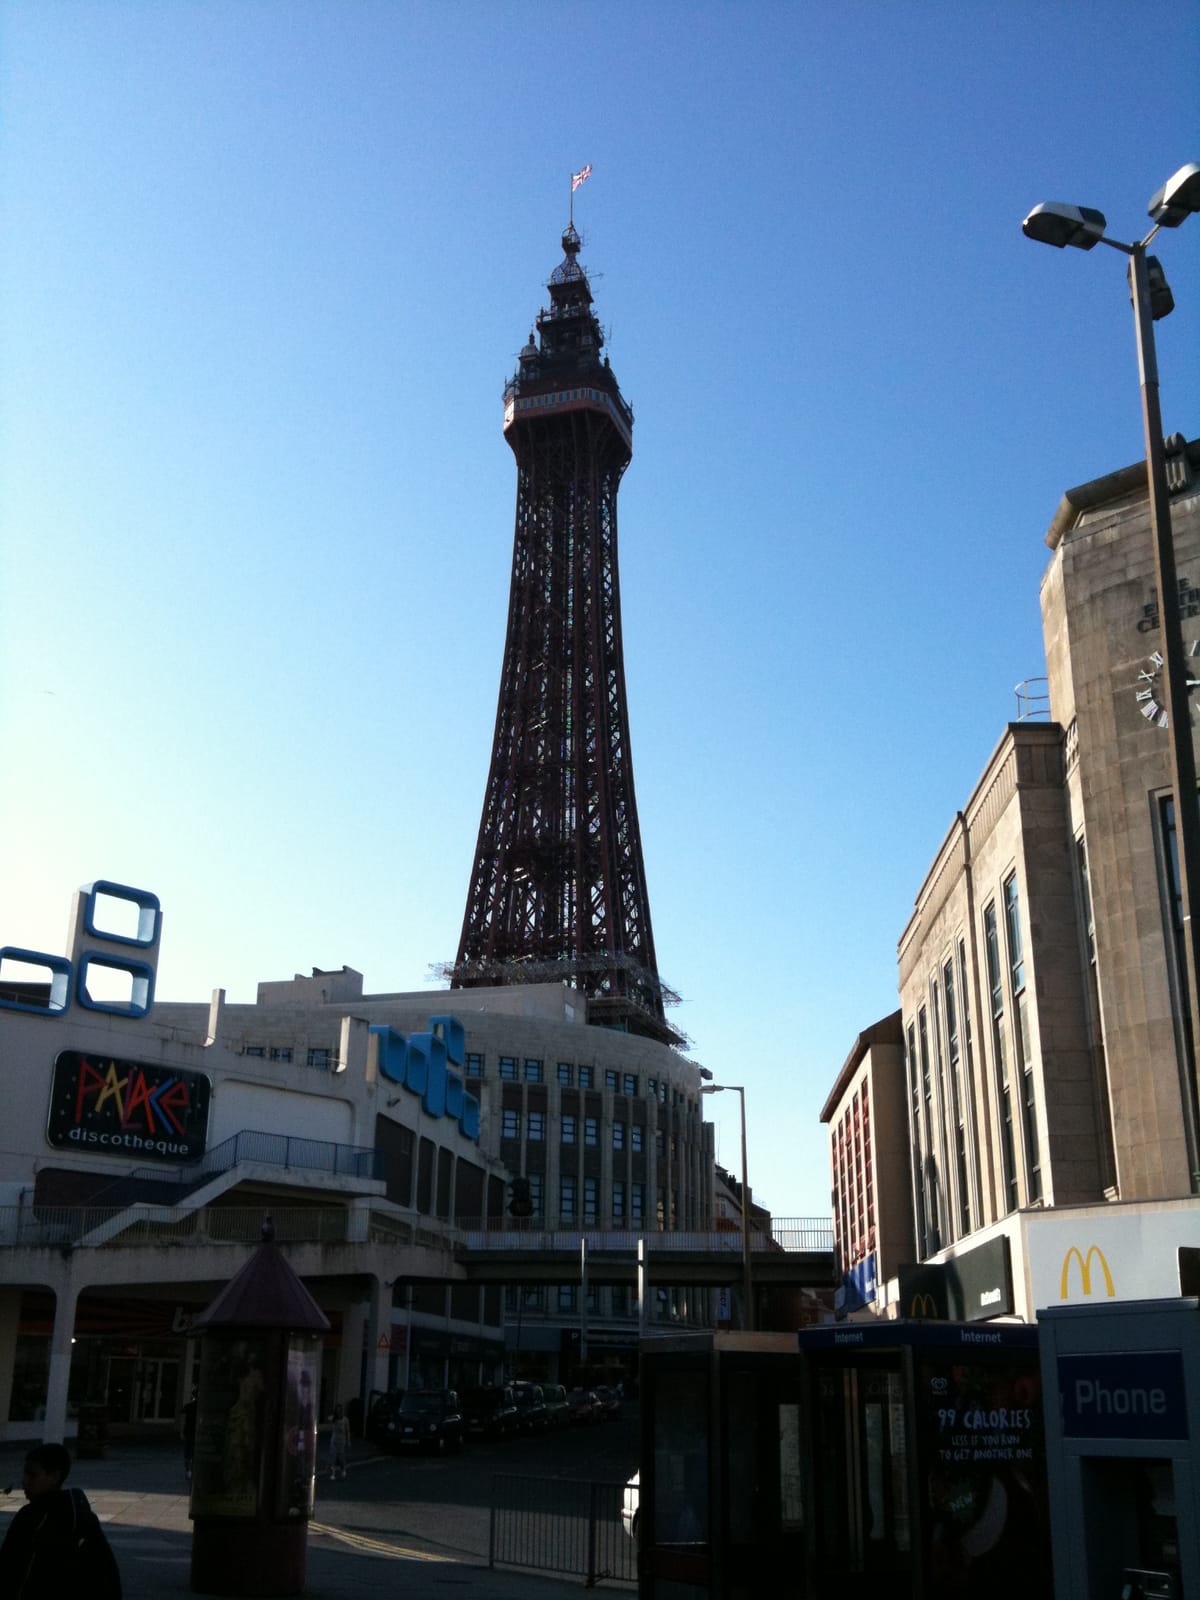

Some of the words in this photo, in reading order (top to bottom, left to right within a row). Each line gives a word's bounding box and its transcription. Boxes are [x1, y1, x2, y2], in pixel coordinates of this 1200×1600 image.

[68, 1127, 190, 1156] discotheque
[834, 1331, 864, 1344] Internet
[960, 1330, 1002, 1344] Internet
[1075, 1379, 1167, 1416] Phone
[937, 1408, 957, 1431] 99
[963, 1408, 1031, 1430] CALORIES
[952, 1435, 968, 1446] LESS
[971, 1435, 979, 1446] IF
[982, 1435, 999, 1446] YOU
[1001, 1434, 1020, 1446] RUN
[938, 1449, 952, 1461] TO
[954, 1449, 971, 1461] GET
[973, 1448, 1013, 1461] ANOTHER
[1016, 1448, 1033, 1461] ONE
